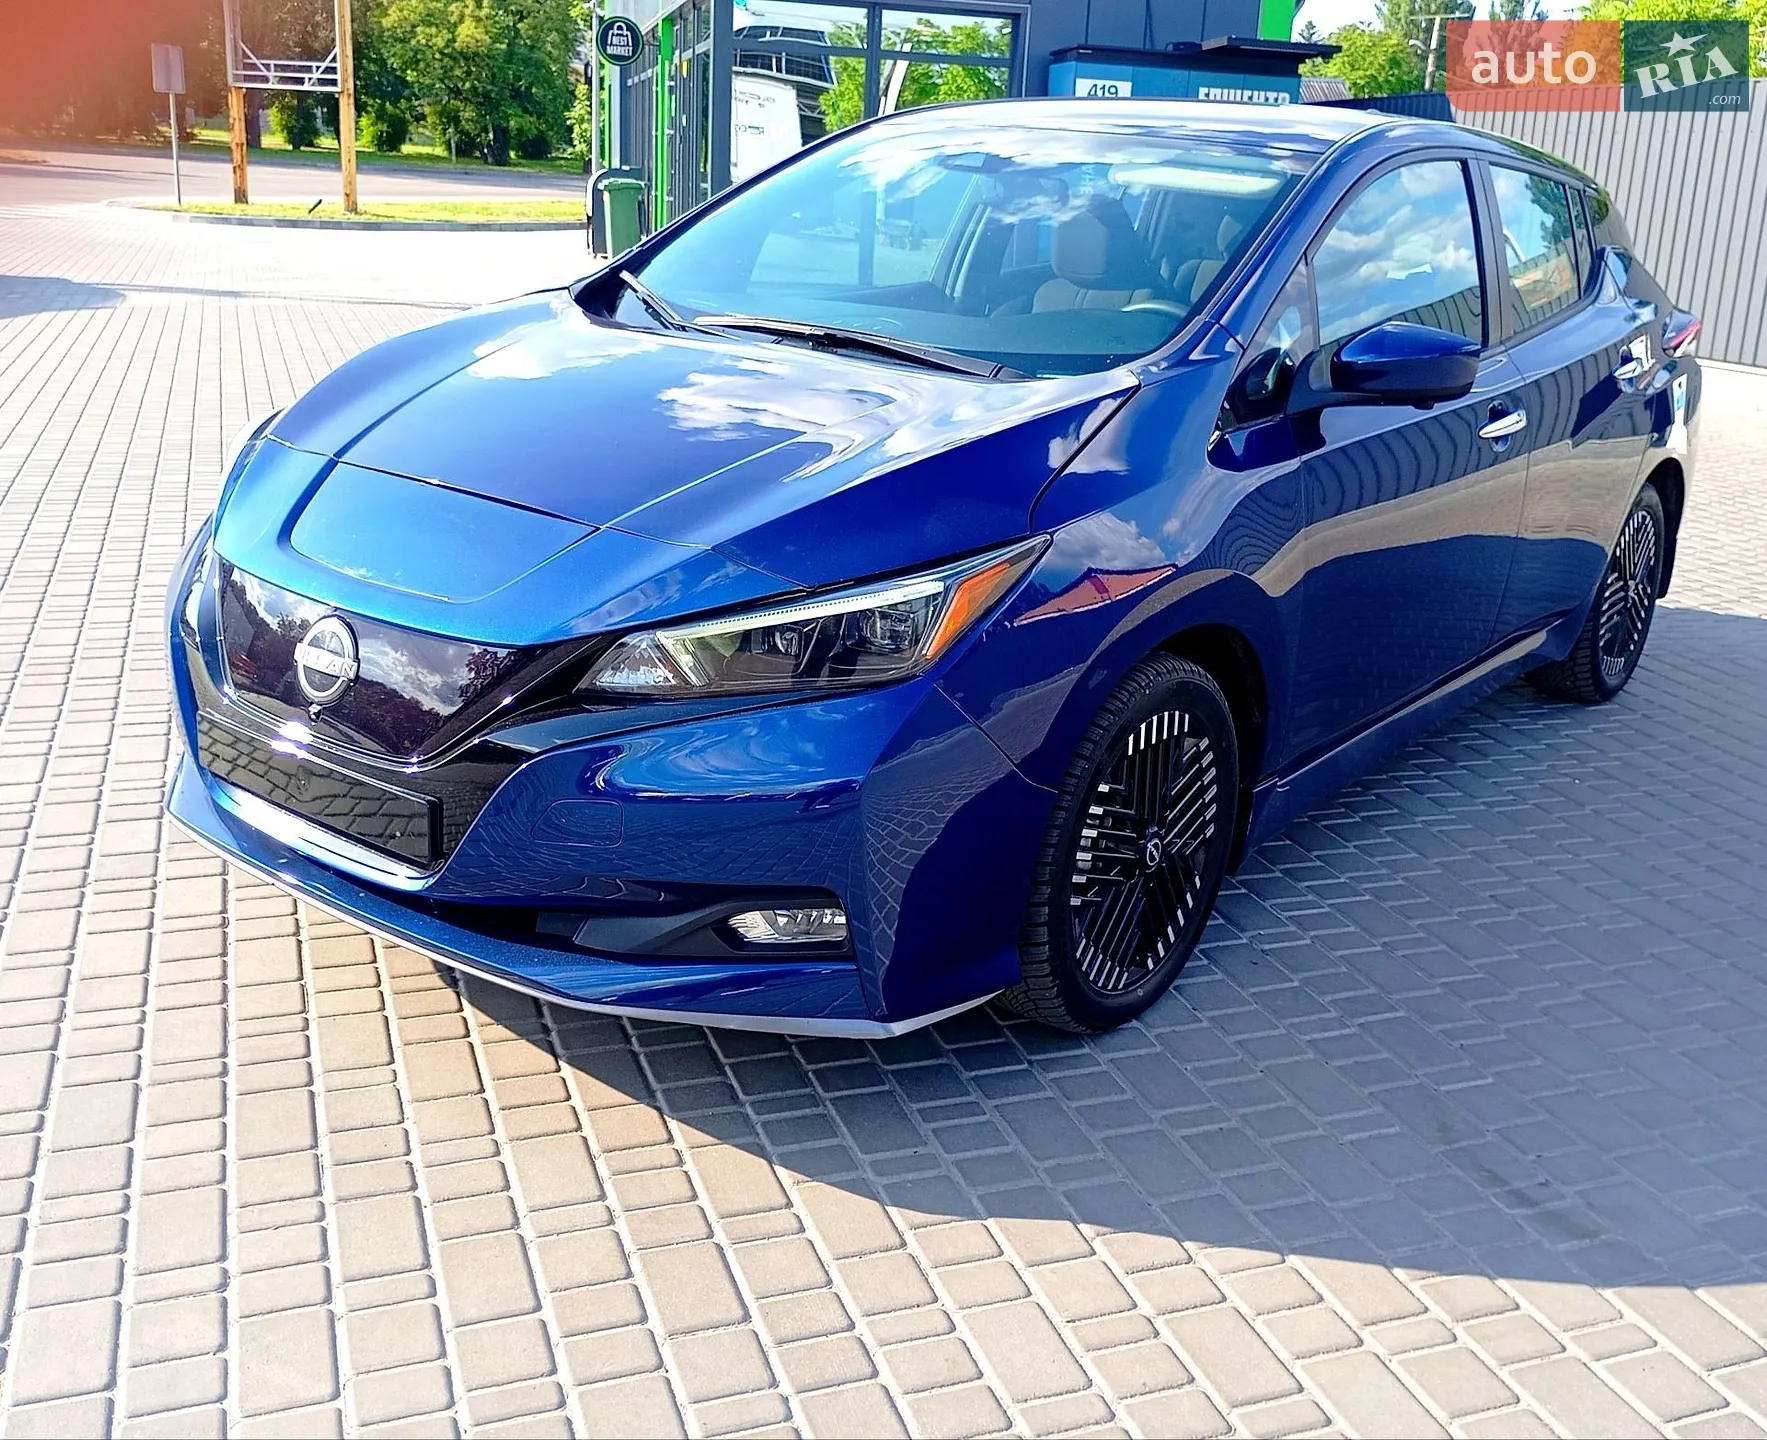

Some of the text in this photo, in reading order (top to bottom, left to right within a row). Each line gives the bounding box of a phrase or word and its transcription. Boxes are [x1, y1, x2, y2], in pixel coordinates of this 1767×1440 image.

[612, 36, 627, 45] BEST
[606, 45, 633, 57] MARKET
[1087, 84, 1118, 97] 419
